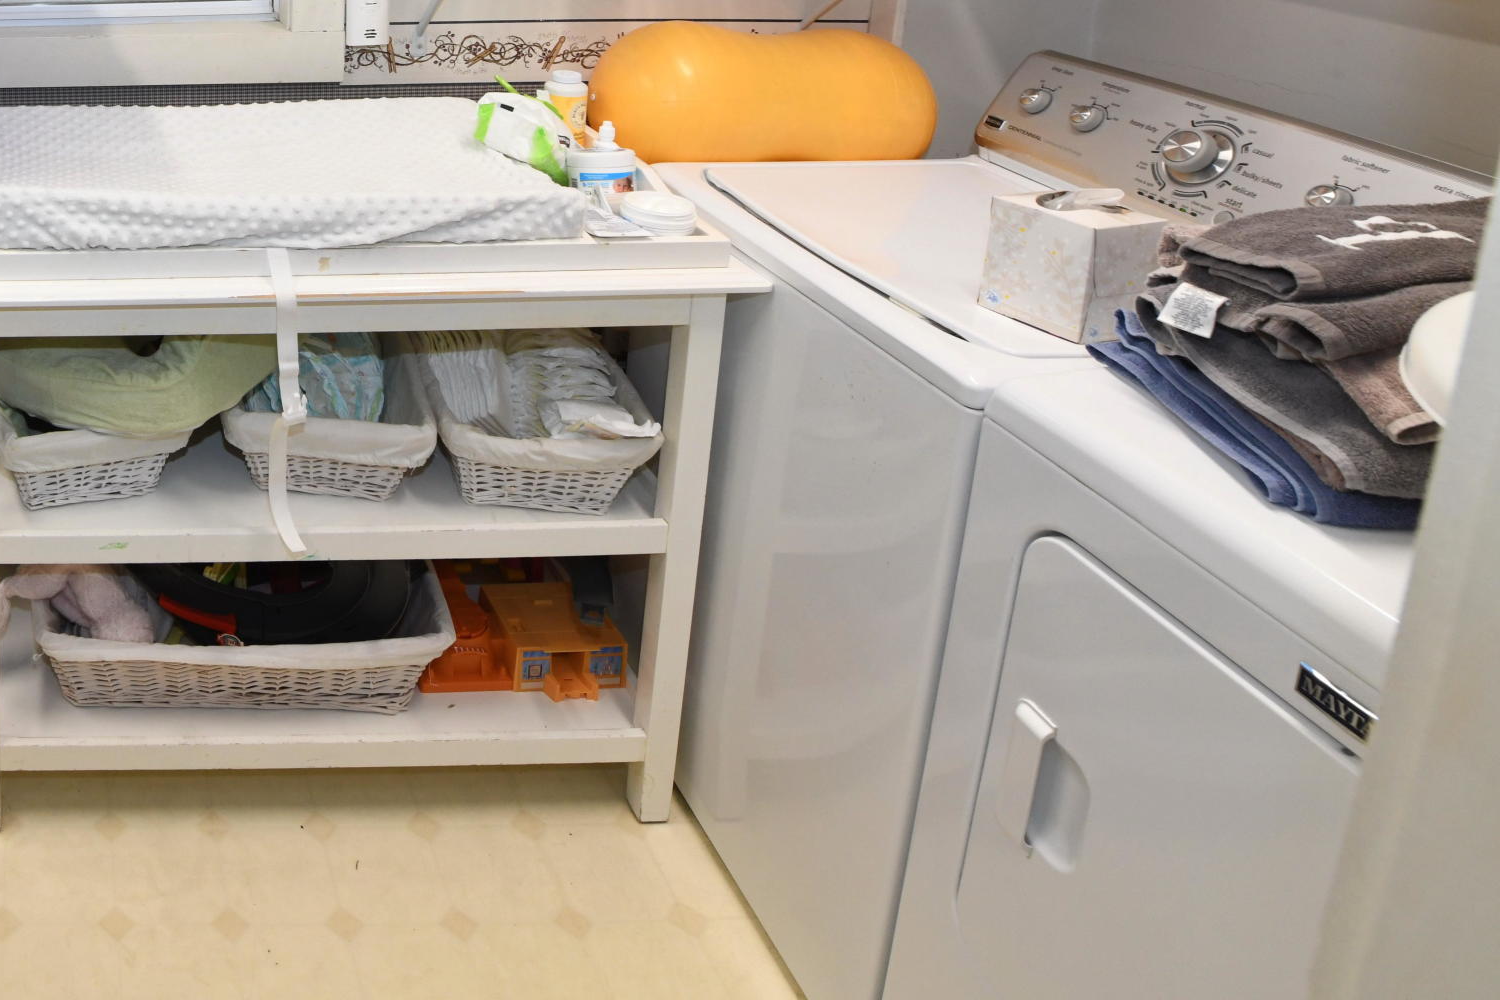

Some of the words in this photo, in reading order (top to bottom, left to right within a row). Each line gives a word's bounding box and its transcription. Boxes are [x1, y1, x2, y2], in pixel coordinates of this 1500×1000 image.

[1252, 148, 1275, 159] casual
[1360, 159, 1391, 174] softener
[1241, 169, 1283, 190] bulky/sheets
[1231, 185, 1258, 199] delicate
[1433, 184, 1454, 195] extra
[1225, 198, 1243, 209] start
[1301, 675, 1368, 735] MAYT
